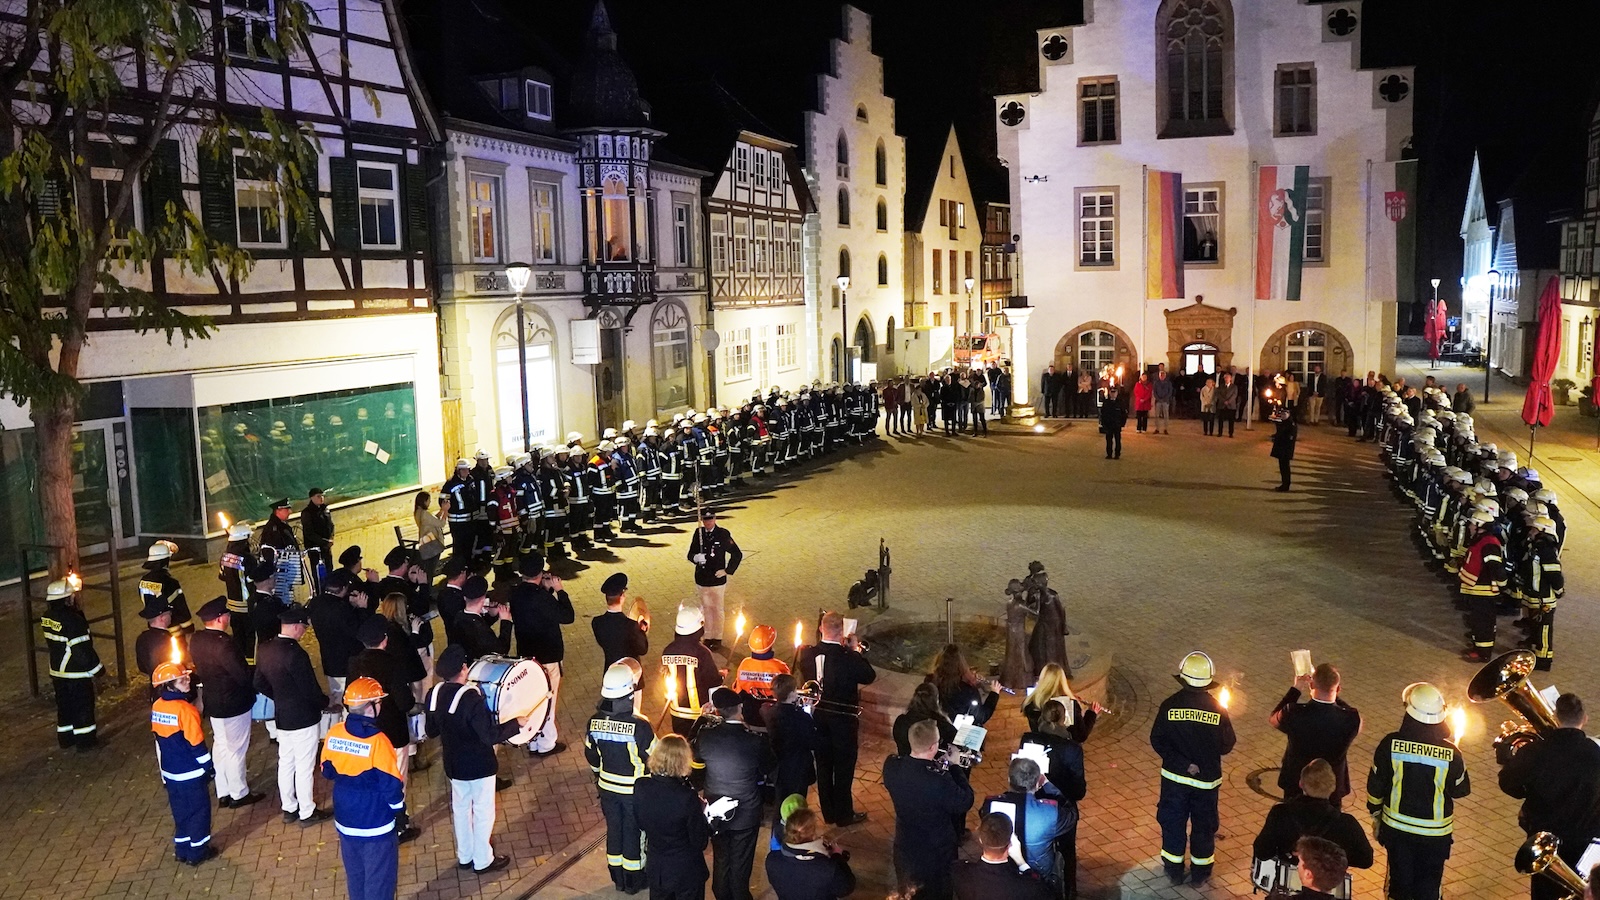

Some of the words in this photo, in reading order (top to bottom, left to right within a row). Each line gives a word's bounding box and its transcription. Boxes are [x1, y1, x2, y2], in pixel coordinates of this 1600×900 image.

[663, 656, 697, 665] FEUERWEHR
[510, 668, 529, 687] SONOR
[1169, 709, 1219, 724] FEUERWEHR
[591, 720, 634, 734] FEUERWEHR
[1393, 740, 1452, 760] FEUERWEHR
